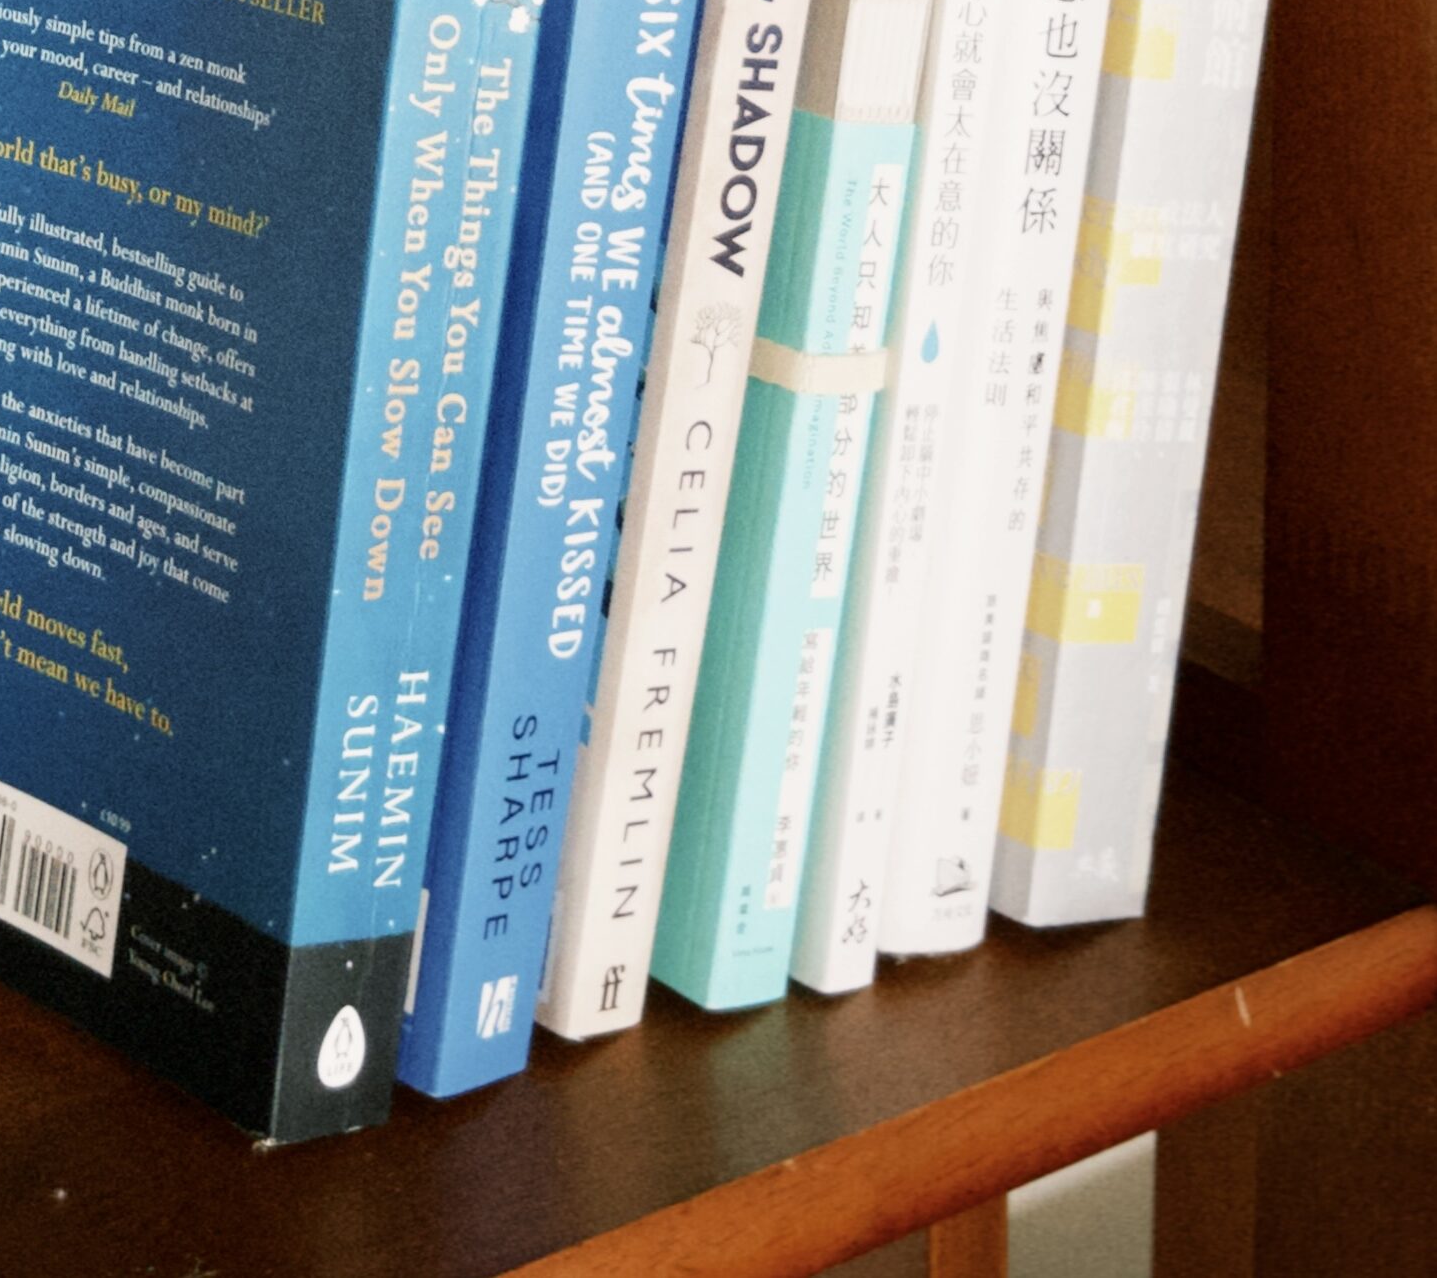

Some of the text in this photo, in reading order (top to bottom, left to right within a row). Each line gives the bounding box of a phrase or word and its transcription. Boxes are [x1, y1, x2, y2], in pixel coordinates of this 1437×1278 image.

[0, 39, 38, 59] your
[39, 48, 89, 76] mood,
[91, 62, 140, 86] career
[154, 78, 183, 100] and
[44, 14, 96, 45] simple
[98, 29, 126, 55] tips
[127, 32, 165, 62] from
[178, 52, 204, 72] zen
[205, 60, 247, 85] monk
[57, 80, 137, 118] Daily Mail
[610, 72, 676, 213] times
[95, 159, 144, 206] busy,
[148, 186, 172, 207] or
[174, 193, 204, 227] my
[709, 23, 784, 278] SHADOW
[840, 177, 860, 209] The
[28, 212, 108, 258] illustrated,
[111, 236, 187, 288] bestselling
[186, 270, 227, 296] guide
[601, 226, 645, 291] WE
[832, 211, 854, 263] World
[32, 246, 85, 283] Sunim,
[99, 267, 163, 307] Buddhist
[164, 295, 205, 323] monk
[207, 304, 242, 337] born
[84, 294, 141, 332] lifetime
[160, 325, 214, 364] change,
[215, 347, 256, 378] offers
[361, 11, 465, 602] Only When You Slow Down
[416, 55, 515, 562] The Things You Can See
[537, 131, 616, 507] (AND ONE TIME WE DID)
[821, 265, 846, 325] Beyond
[20, 345, 54, 369] with
[55, 351, 88, 380] love
[89, 370, 118, 392] and
[118, 379, 209, 430] relationships.
[78, 327, 116, 358] from
[117, 339, 179, 388] handling
[180, 371, 238, 406] setbacks
[575, 304, 634, 482] almost
[811, 174, 894, 585] 大人只知部分的世界
[0, 389, 26, 414] the
[27, 404, 93, 440] anxieties
[95, 424, 124, 452] that
[125, 434, 158, 466] have
[159, 448, 214, 490] become
[215, 479, 246, 506] part
[83, 456, 136, 494] simple,
[137, 481, 237, 536] compassionate
[548, 498, 604, 659] KISSED
[25, 608, 87, 649] moves
[89, 628, 129, 674] fast,
[610, 419, 713, 920] CELIA FREMLIN
[15, 646, 69, 684] mean
[73, 671, 101, 699] we
[104, 677, 146, 721] have
[150, 706, 174, 737] to.
[325, 693, 382, 877] SUNIM
[369, 669, 432, 890] HAEMIN
[519, 749, 561, 889] TESS
[483, 714, 538, 941] SHARPE
